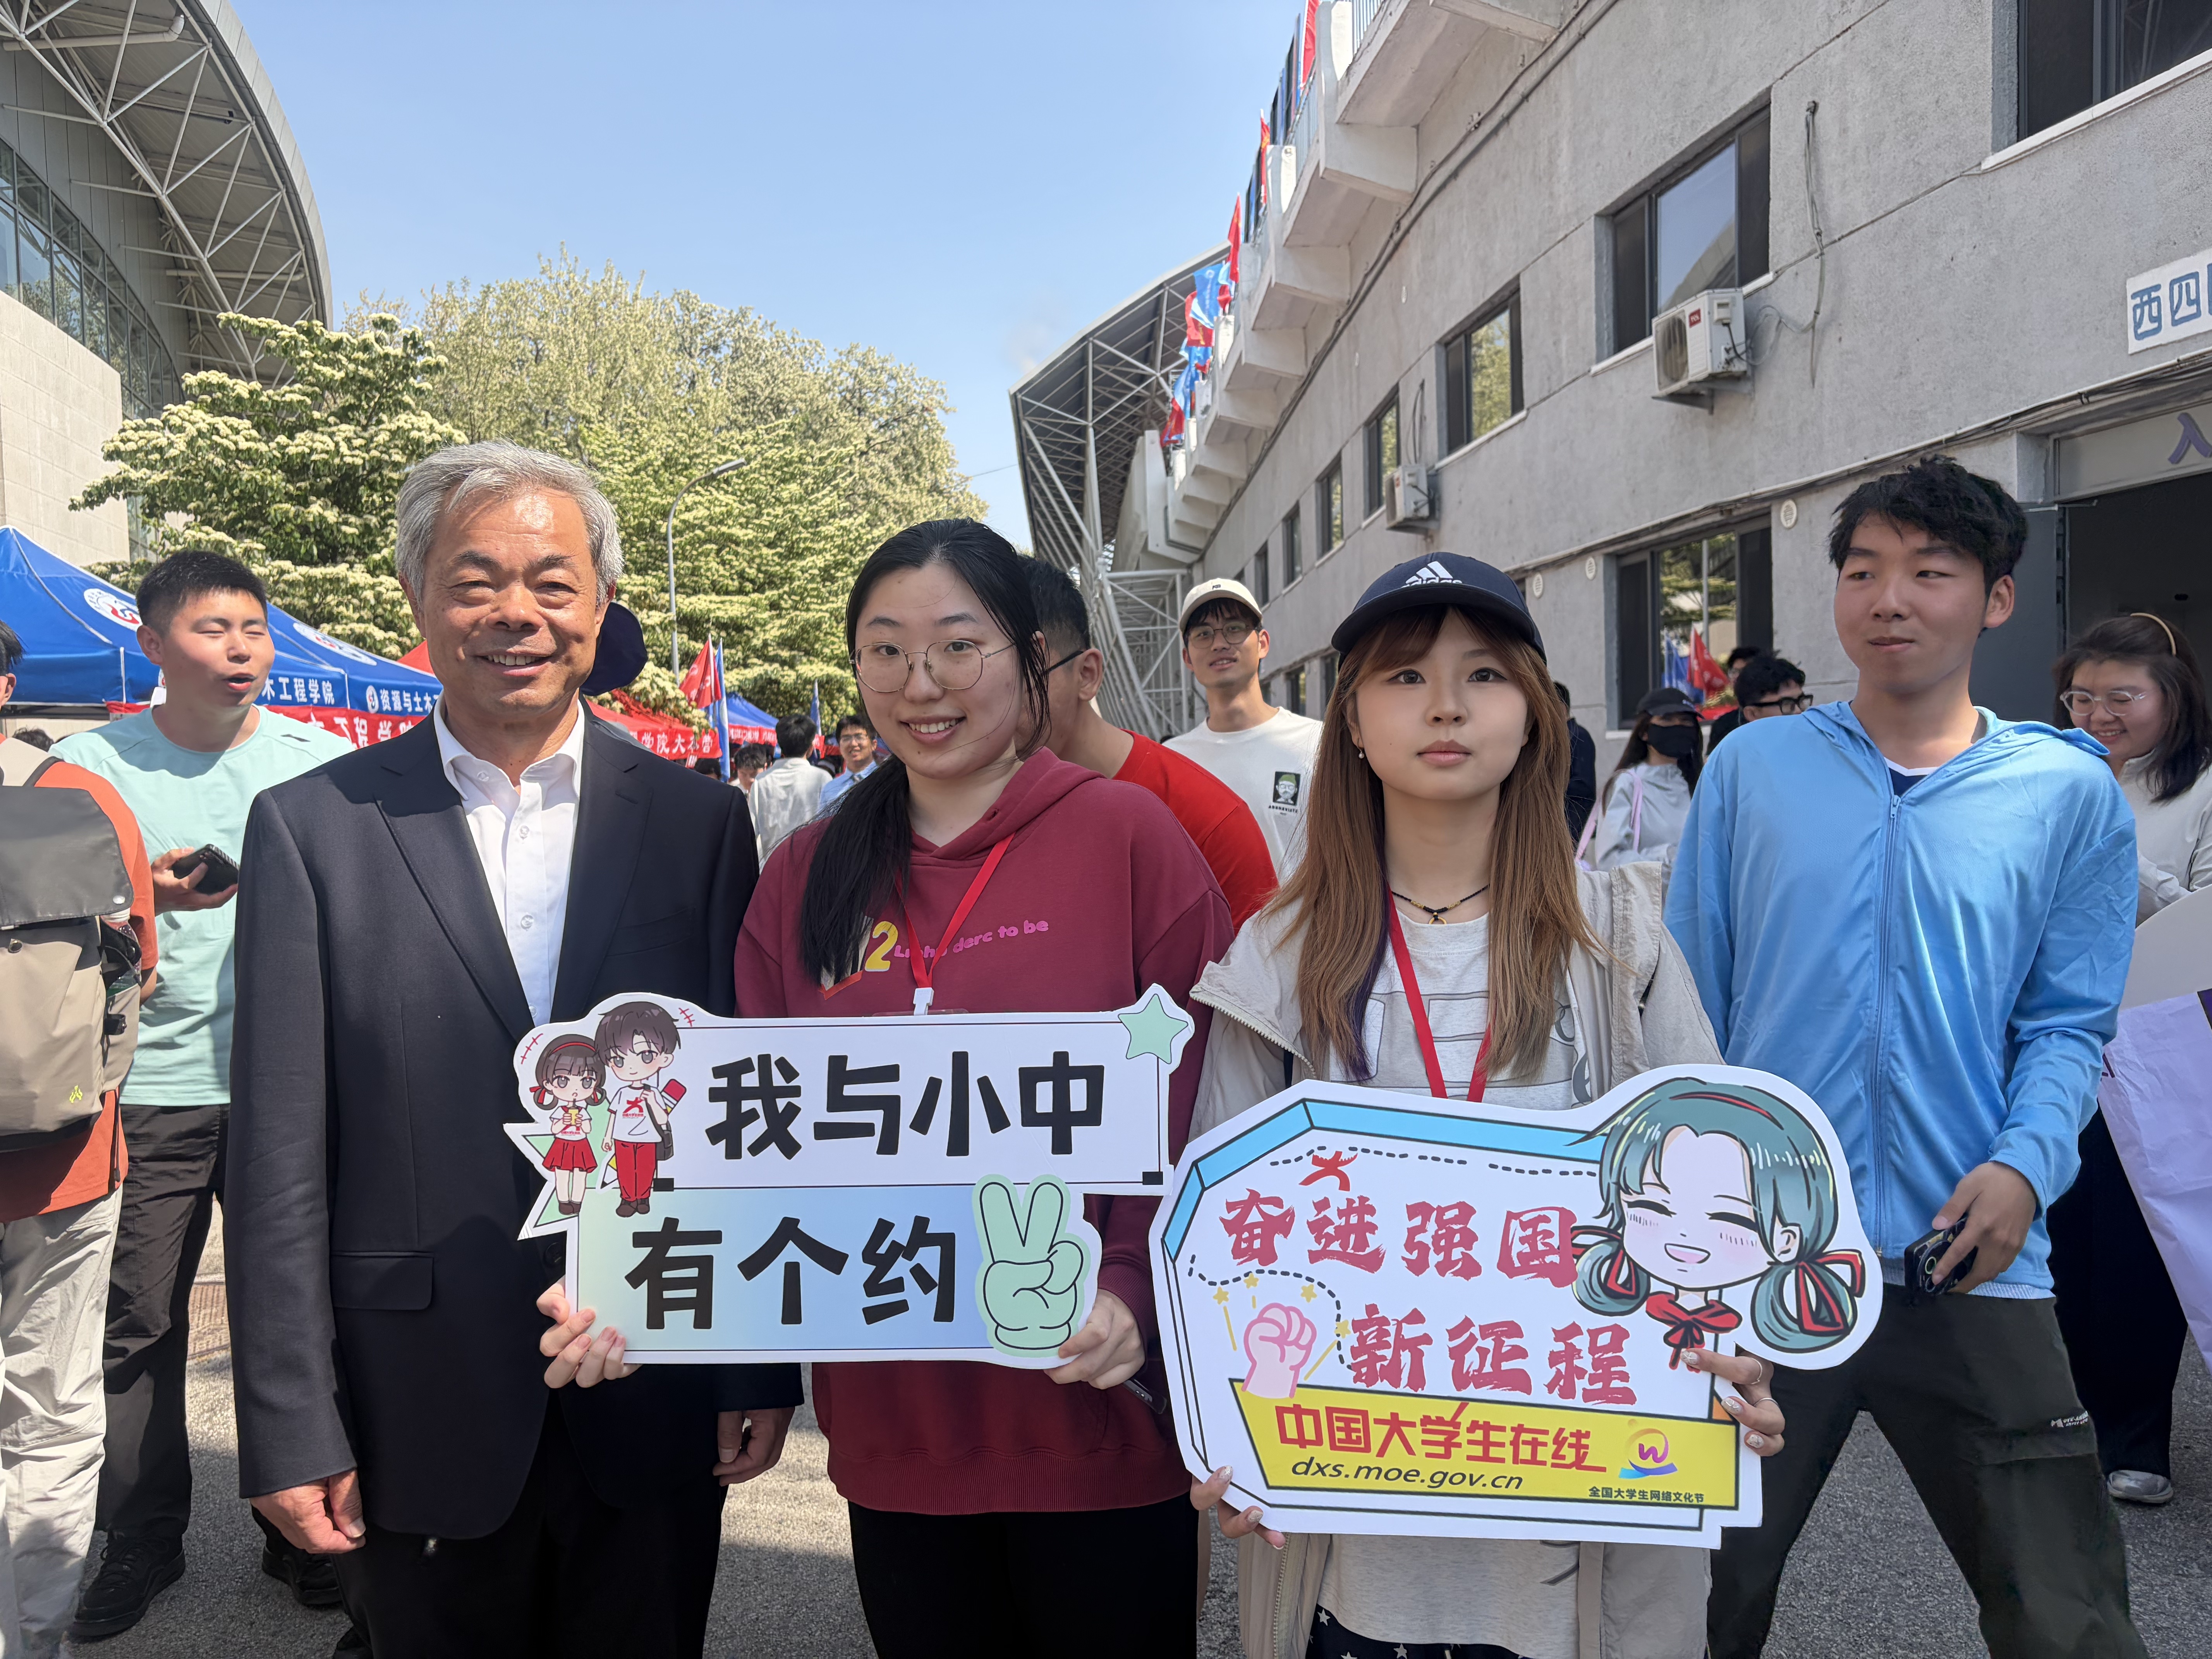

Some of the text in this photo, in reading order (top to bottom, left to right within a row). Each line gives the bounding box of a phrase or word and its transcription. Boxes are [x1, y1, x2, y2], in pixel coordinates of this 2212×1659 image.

[2131, 263, 2212, 340] 西四
[2168, 413, 2212, 464] 入
[865, 921, 898, 972] 2
[998, 926, 1018, 938] to
[1024, 920, 1049, 934] be
[705, 1051, 1104, 1160] 我与小中
[625, 1216, 955, 1329] 有个约
[1219, 1188, 1579, 1288] 奋进强国
[1348, 1304, 1636, 1405] 新征程
[1275, 1402, 1607, 1472] 中国大学生在线
[1291, 1457, 1523, 1489] dxs.moe.gov.cn
[1589, 1486, 1704, 1503] 全国大学生网络文化节
